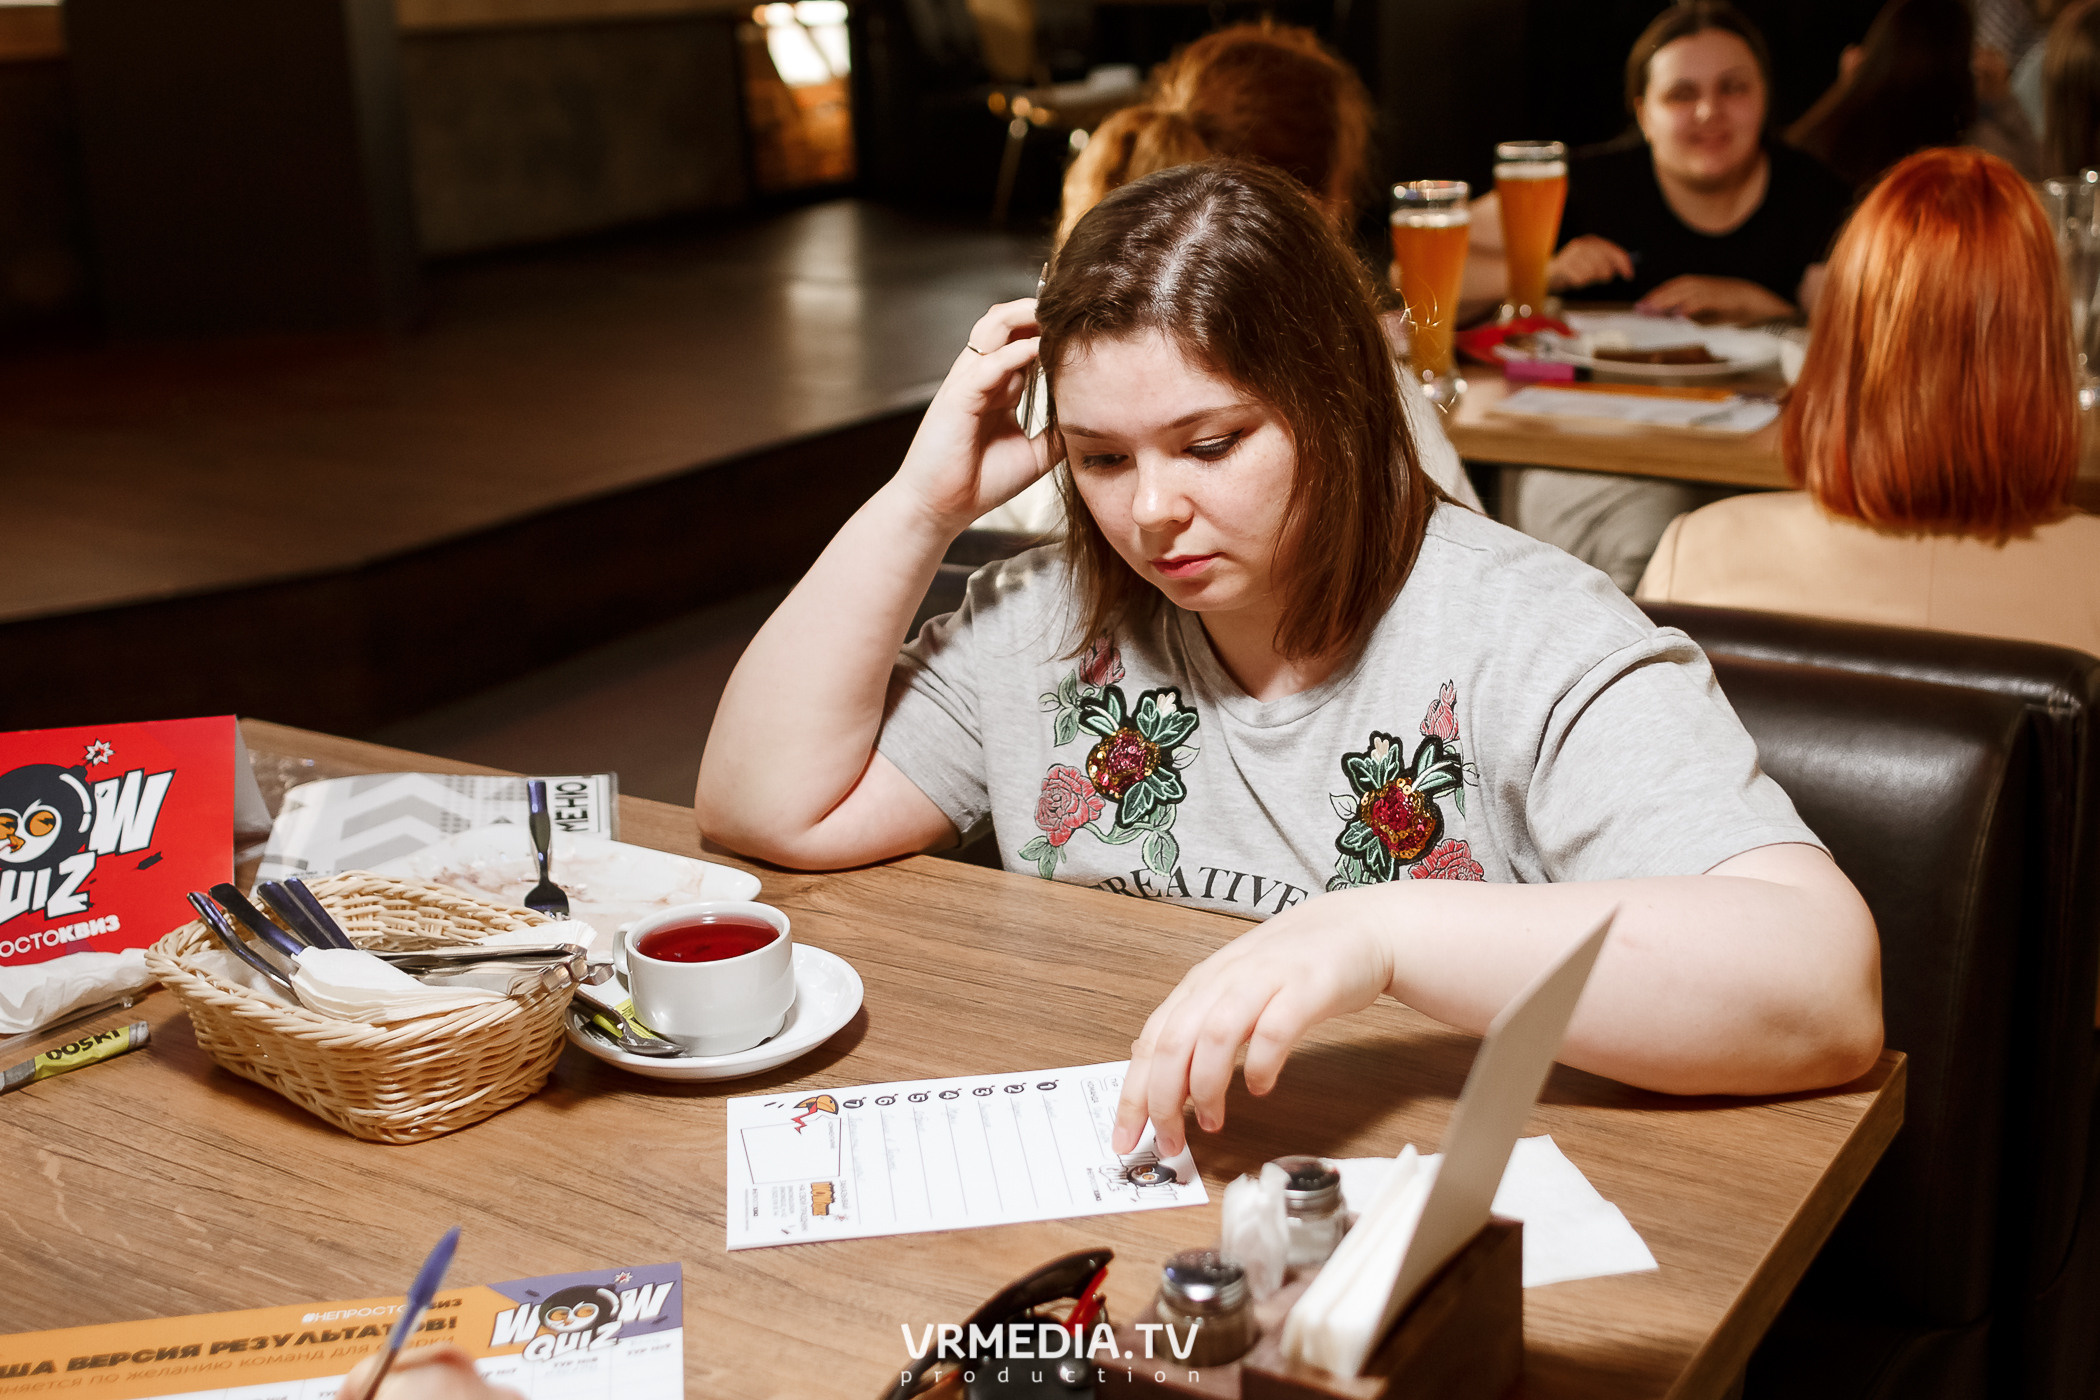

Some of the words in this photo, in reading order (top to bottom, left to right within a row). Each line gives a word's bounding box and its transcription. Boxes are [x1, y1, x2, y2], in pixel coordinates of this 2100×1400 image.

[554, 781, 589, 832] МЕНЮ
[0, 851, 97, 922] UIZ
[1090, 866, 1309, 915] REATIVE
[0, 914, 121, 958] ОСТОКВИЗ
[0, 1359, 57, 1379] ША
[66, 1343, 203, 1372] ВЕРСИЯ
[522, 1320, 624, 1362] QUIZ
[0, 1377, 82, 1396] няется
[126, 1360, 233, 1381] желанию
[240, 1350, 324, 1367] команд
